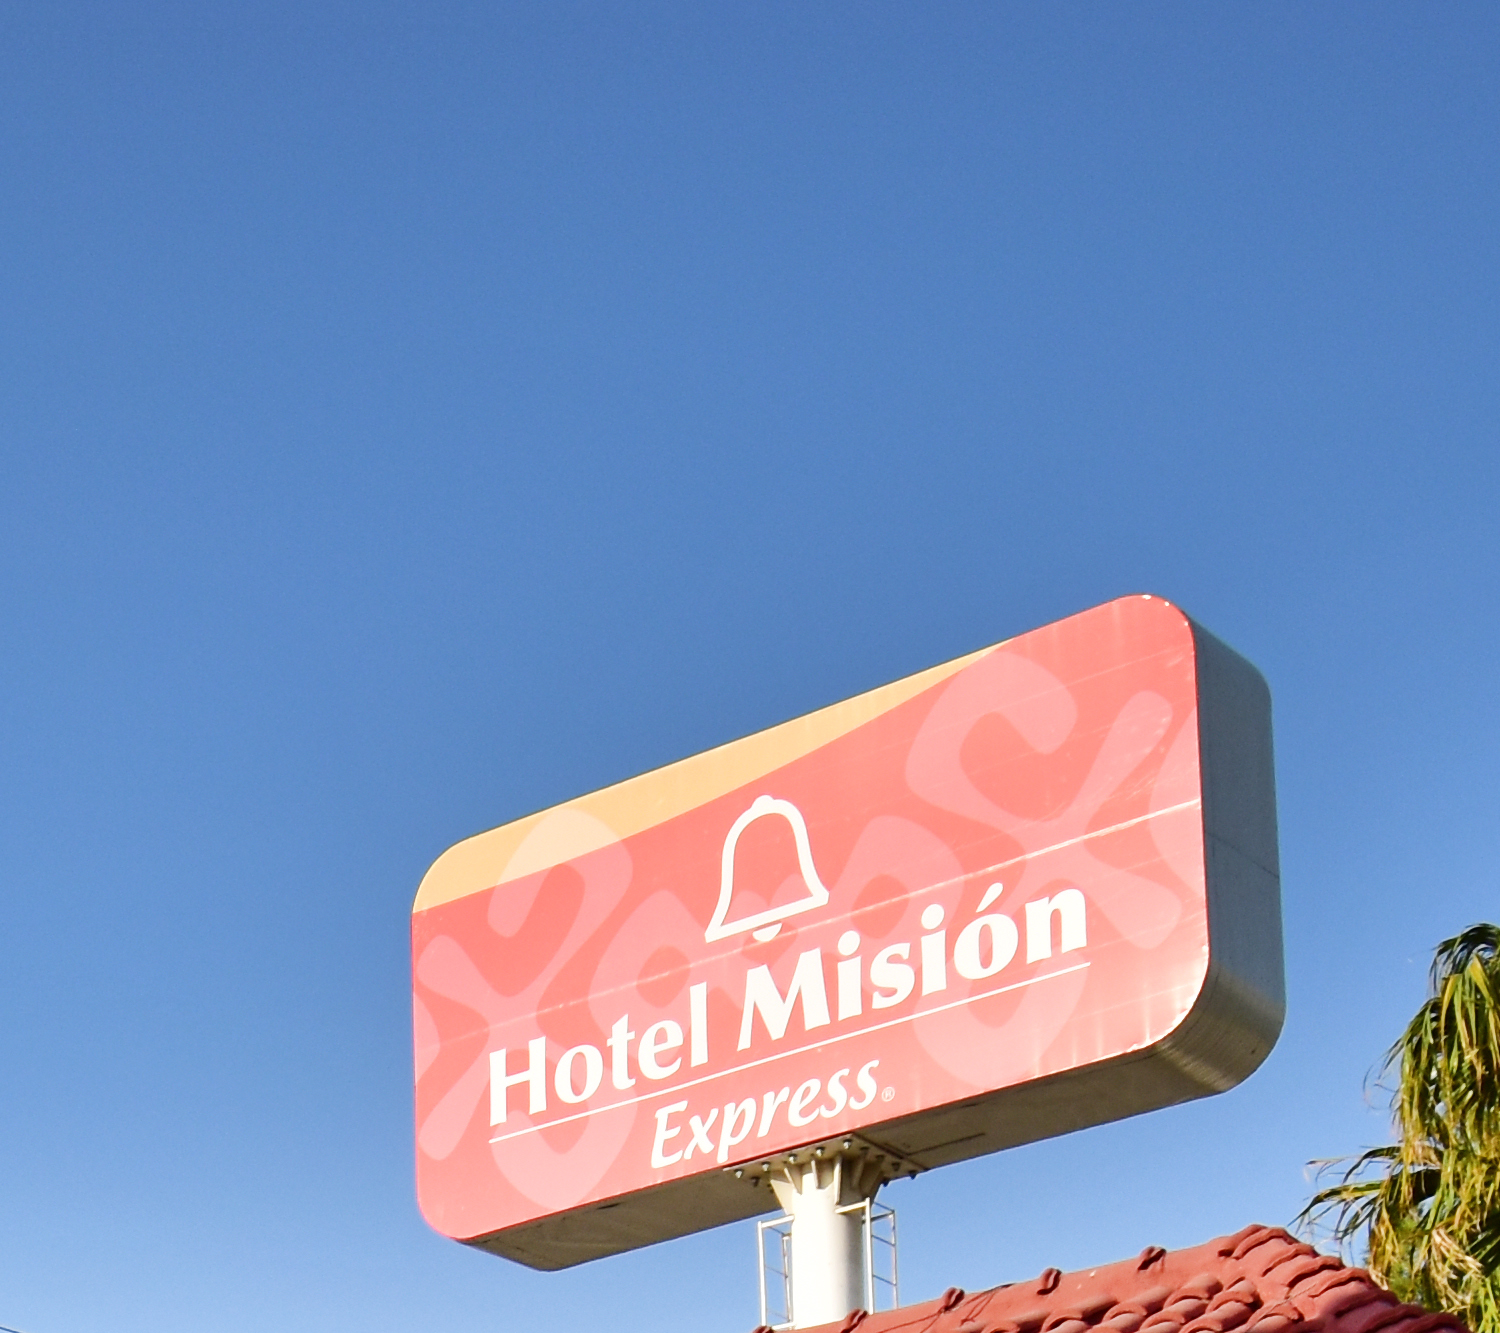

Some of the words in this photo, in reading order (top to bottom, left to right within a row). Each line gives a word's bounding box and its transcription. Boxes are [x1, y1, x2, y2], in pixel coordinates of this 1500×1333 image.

[489, 981, 709, 1127] Hotel
[736, 882, 1087, 1052] Misión
[650, 1059, 880, 1169] Express
